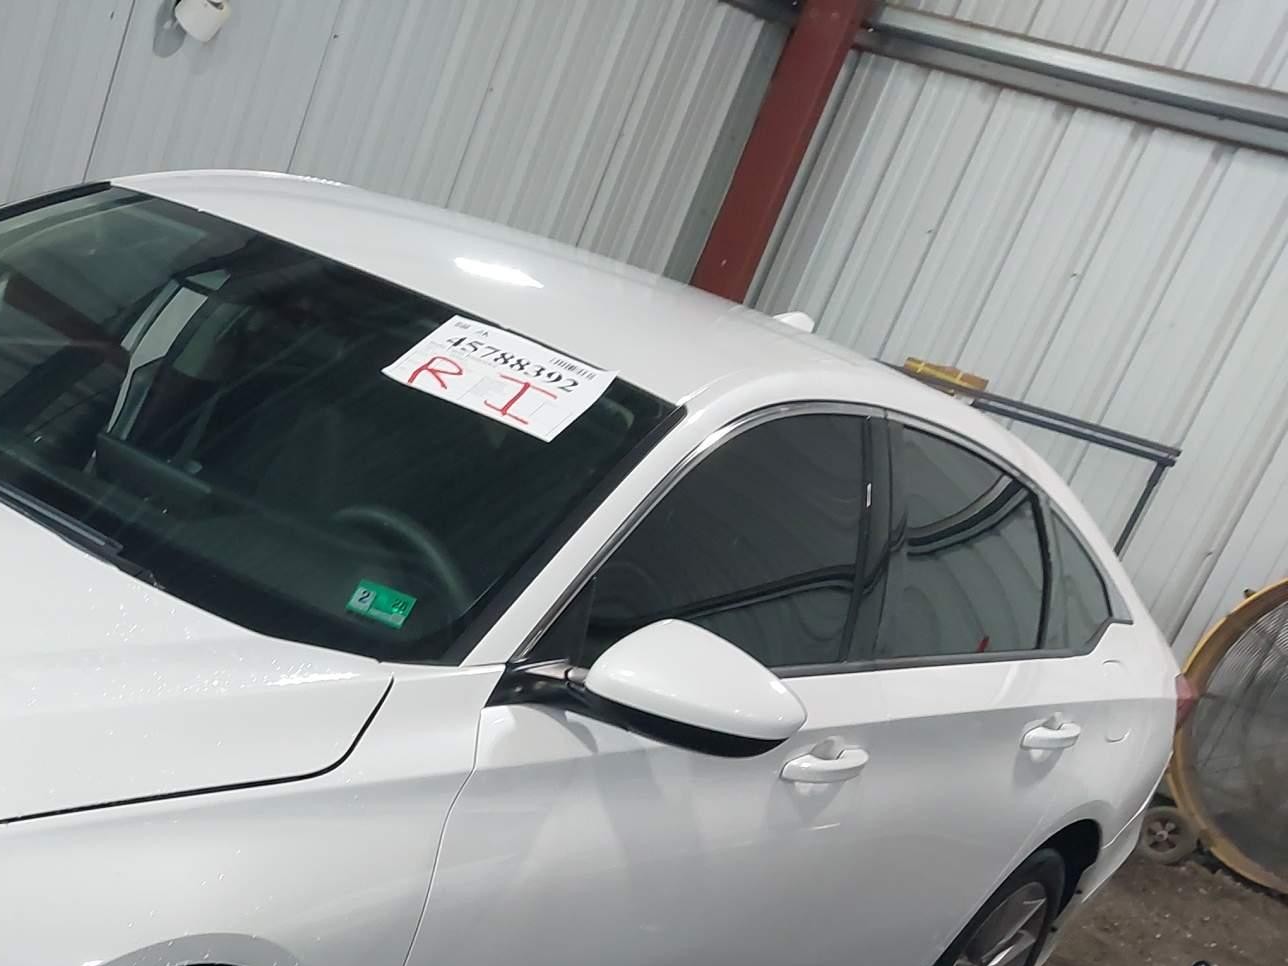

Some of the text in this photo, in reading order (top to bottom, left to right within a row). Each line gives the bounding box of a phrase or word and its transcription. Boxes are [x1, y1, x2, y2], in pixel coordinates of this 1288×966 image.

[408, 356, 463, 389] R
[446, 336, 579, 392] 45788392
[358, 590, 370, 603] 2
